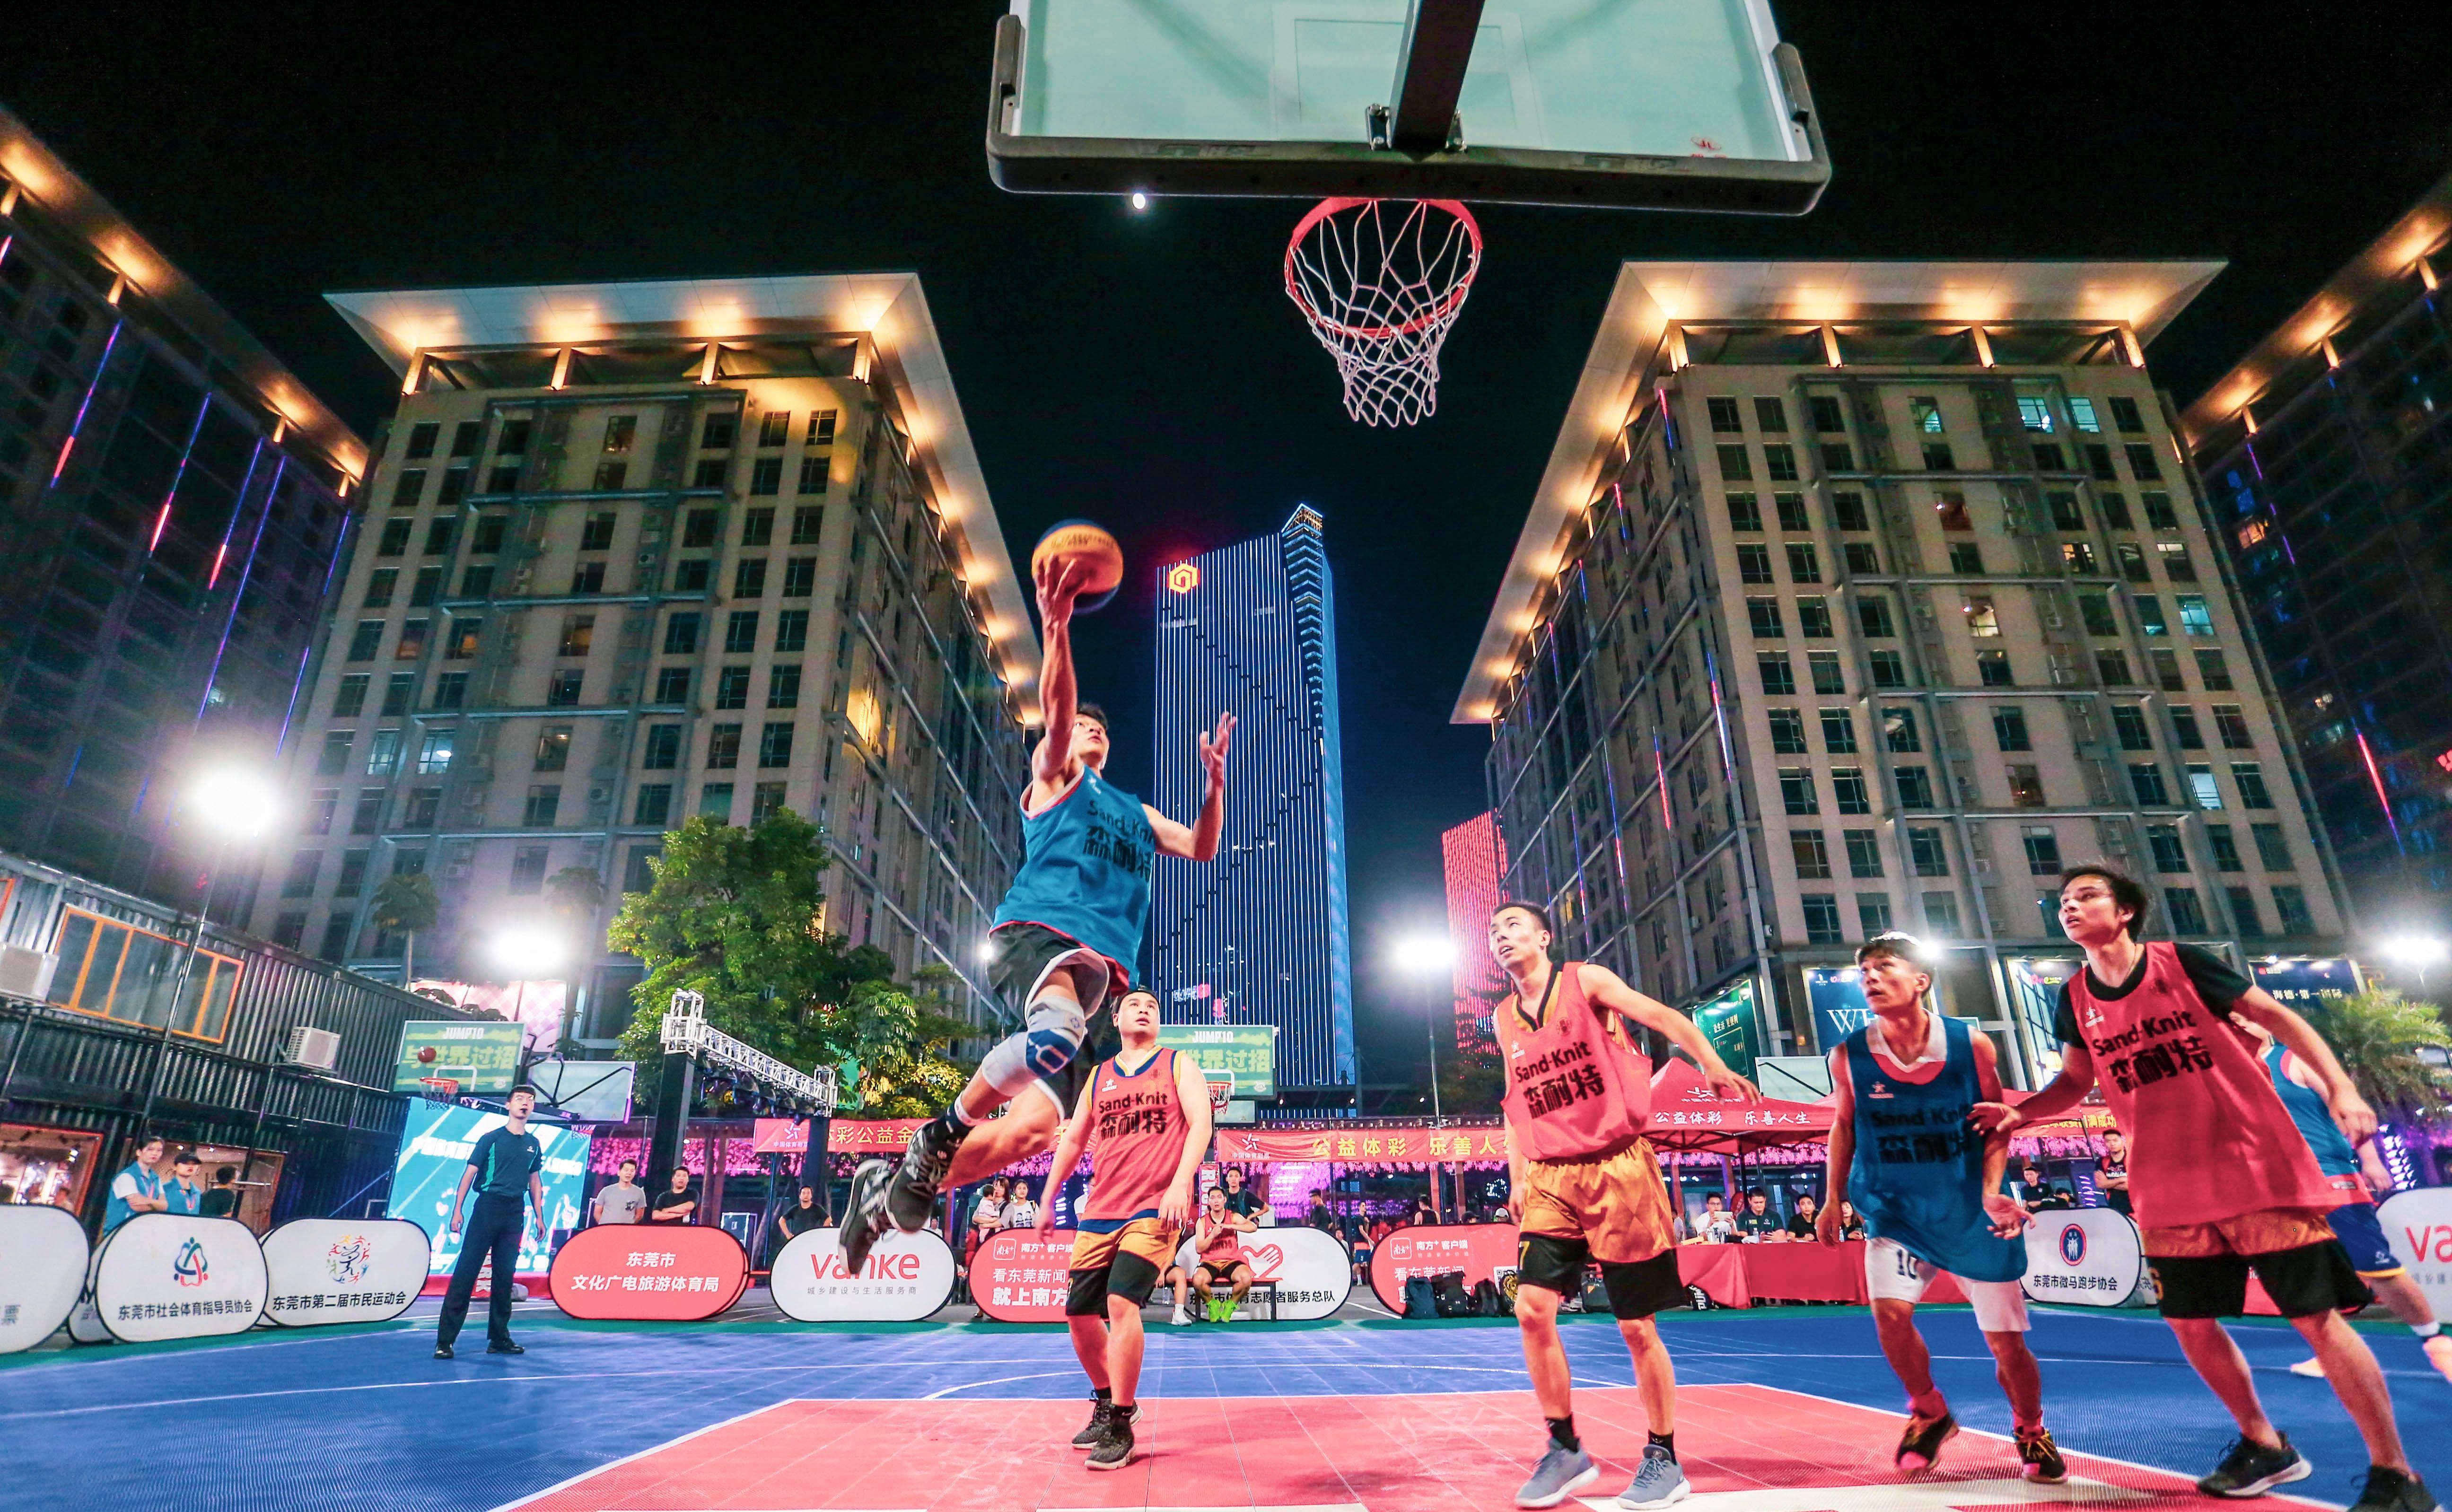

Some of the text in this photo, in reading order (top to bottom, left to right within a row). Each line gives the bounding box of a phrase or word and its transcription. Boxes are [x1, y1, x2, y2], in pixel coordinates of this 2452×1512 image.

[442, 1027, 485, 1040] JUMP10
[1192, 1031, 1234, 1043] JUMP10
[1515, 1041, 1592, 1083] Sand-Knit
[1523, 1064, 1605, 1119] 森耐特
[1099, 1092, 1168, 1113] Sand-Knit
[1100, 1110, 1167, 1141] 森耐特
[1655, 1110, 1811, 1126] 公益体彩 乐善人生
[1312, 1136, 1407, 1157] 公益体彩
[1442, 1240, 1468, 1250] 客户端
[626, 1251, 676, 1267] 东莞市
[571, 1275, 719, 1292] 文化广电旅游体育局
[993, 1268, 1066, 1284] 看东莞新闻
[2033, 1275, 2118, 1291] 东莞市微马跑步协会
[807, 1286, 917, 1295] 城乡建设与生活服务商
[992, 1287, 1068, 1307] 就上南方
[118, 1299, 252, 1320] 东莞市社会体育指导员协会
[273, 1291, 406, 1311] 东莞市第二届市民运动会
